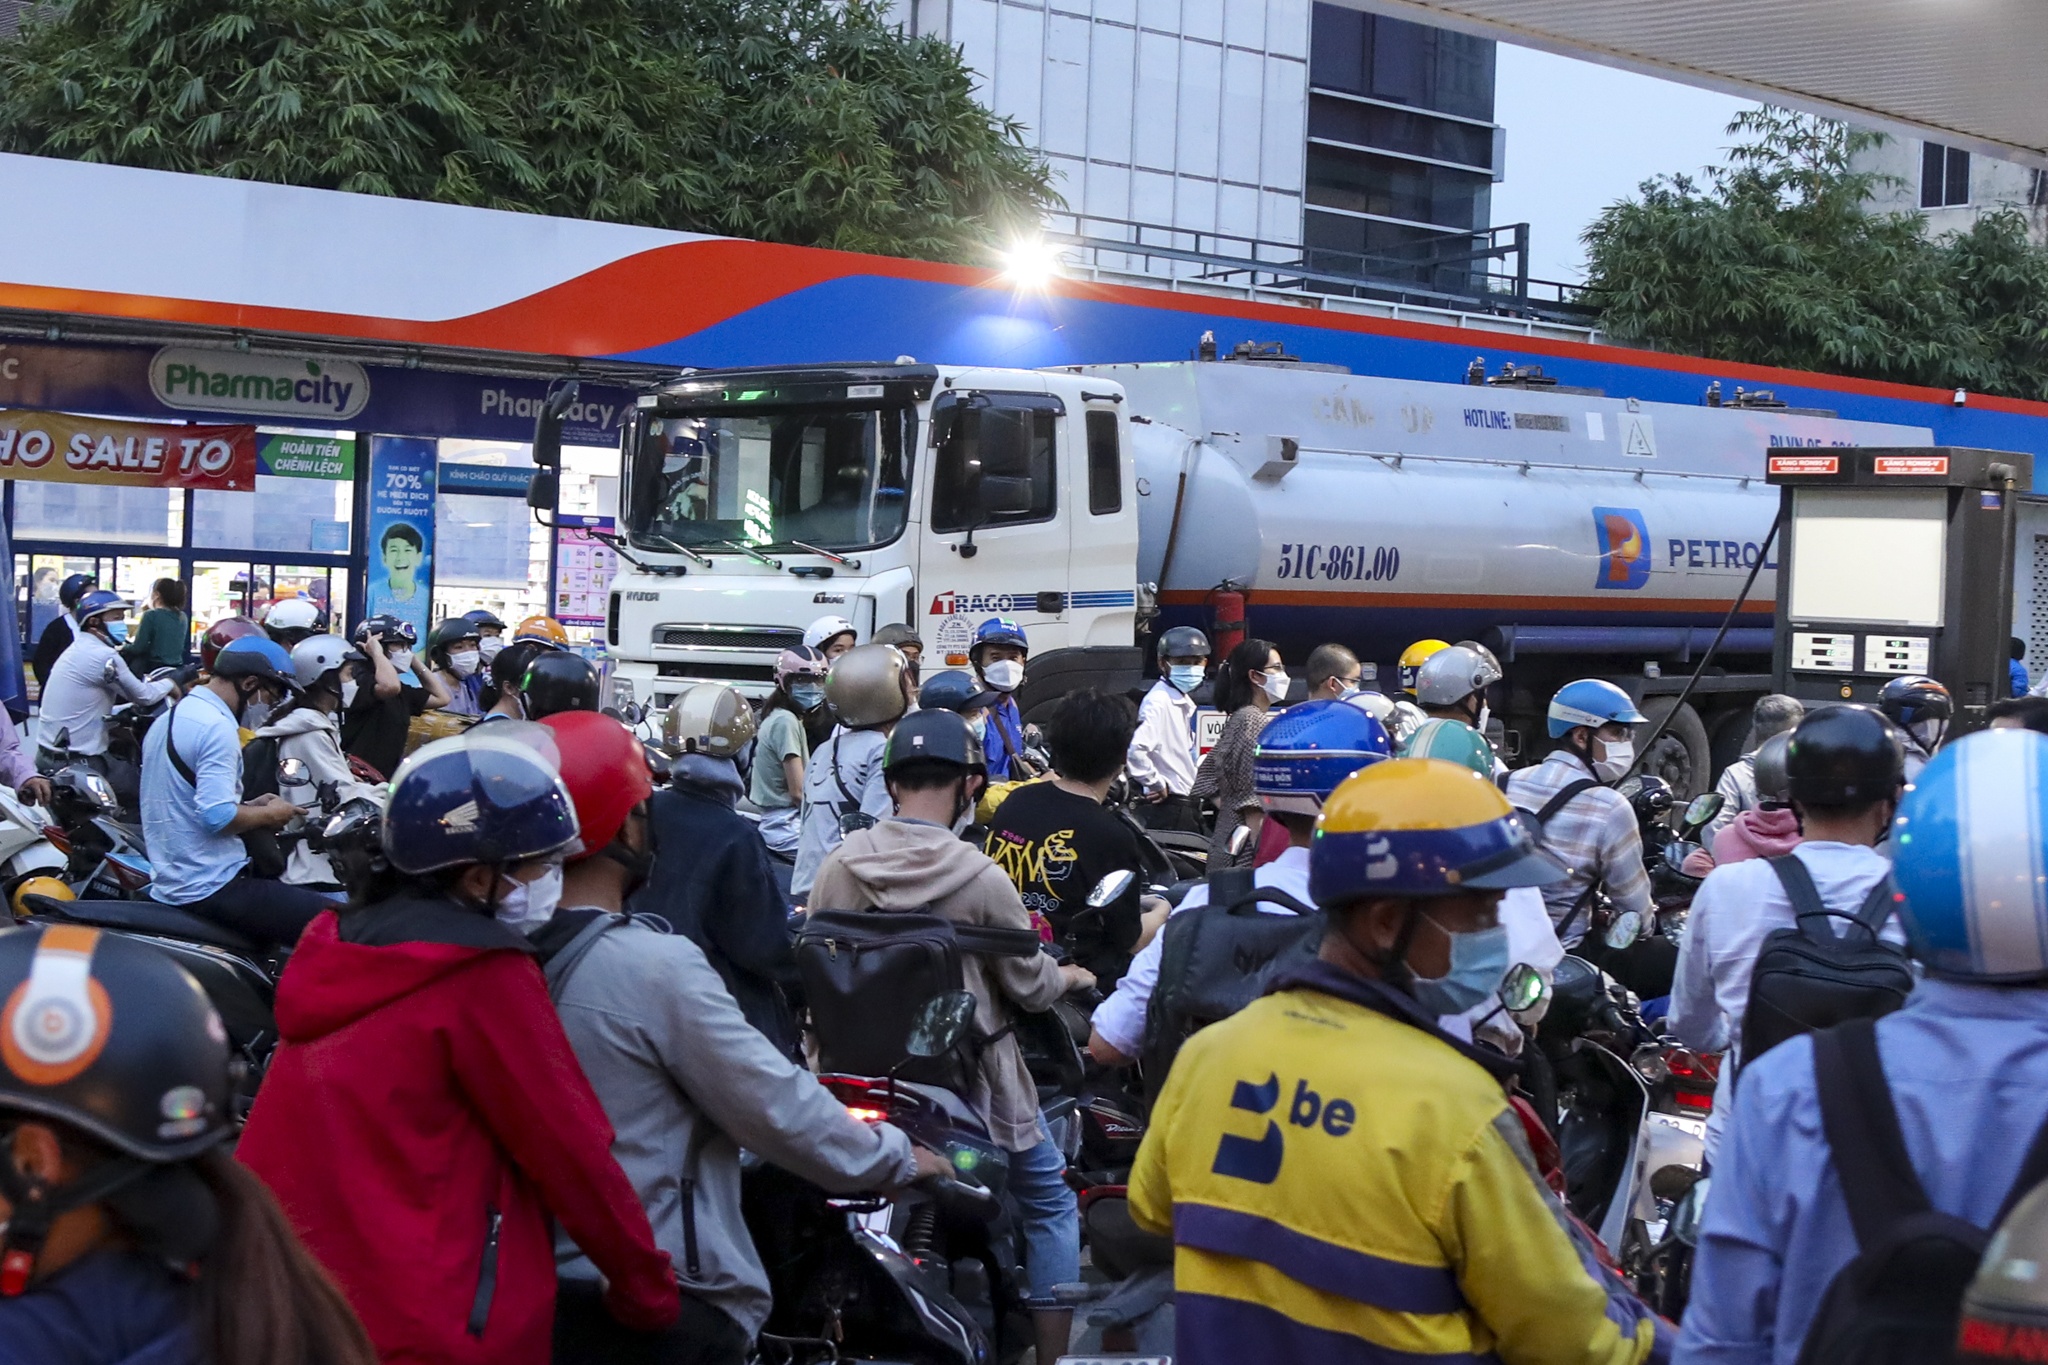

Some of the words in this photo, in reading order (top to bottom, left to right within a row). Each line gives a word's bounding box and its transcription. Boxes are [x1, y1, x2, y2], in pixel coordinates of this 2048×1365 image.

[166, 361, 353, 412] Pharmacity
[481, 389, 614, 430] Pharacy
[1464, 408, 1512, 430] HOTLINE:
[65, 433, 166, 469] SALE
[180, 438, 232, 471] TO
[280, 441, 314, 456] HOÀN
[315, 440, 341, 457] TIỀN
[275, 457, 314, 472] CHÊNH
[314, 458, 344, 476] LỆCH
[450, 470, 468, 479] KÍNH
[492, 472, 507, 482] QUÝ
[509, 473, 534, 483] KHÁC
[386, 473, 422, 489] 70%
[1277, 543, 1400, 581] 51C-861.00
[626, 592, 660, 601] HYUNDAI
[929, 590, 1013, 615] TRAGO
[92, 880, 120, 897] YAMAHA
[1289, 1078, 1357, 1137] be
